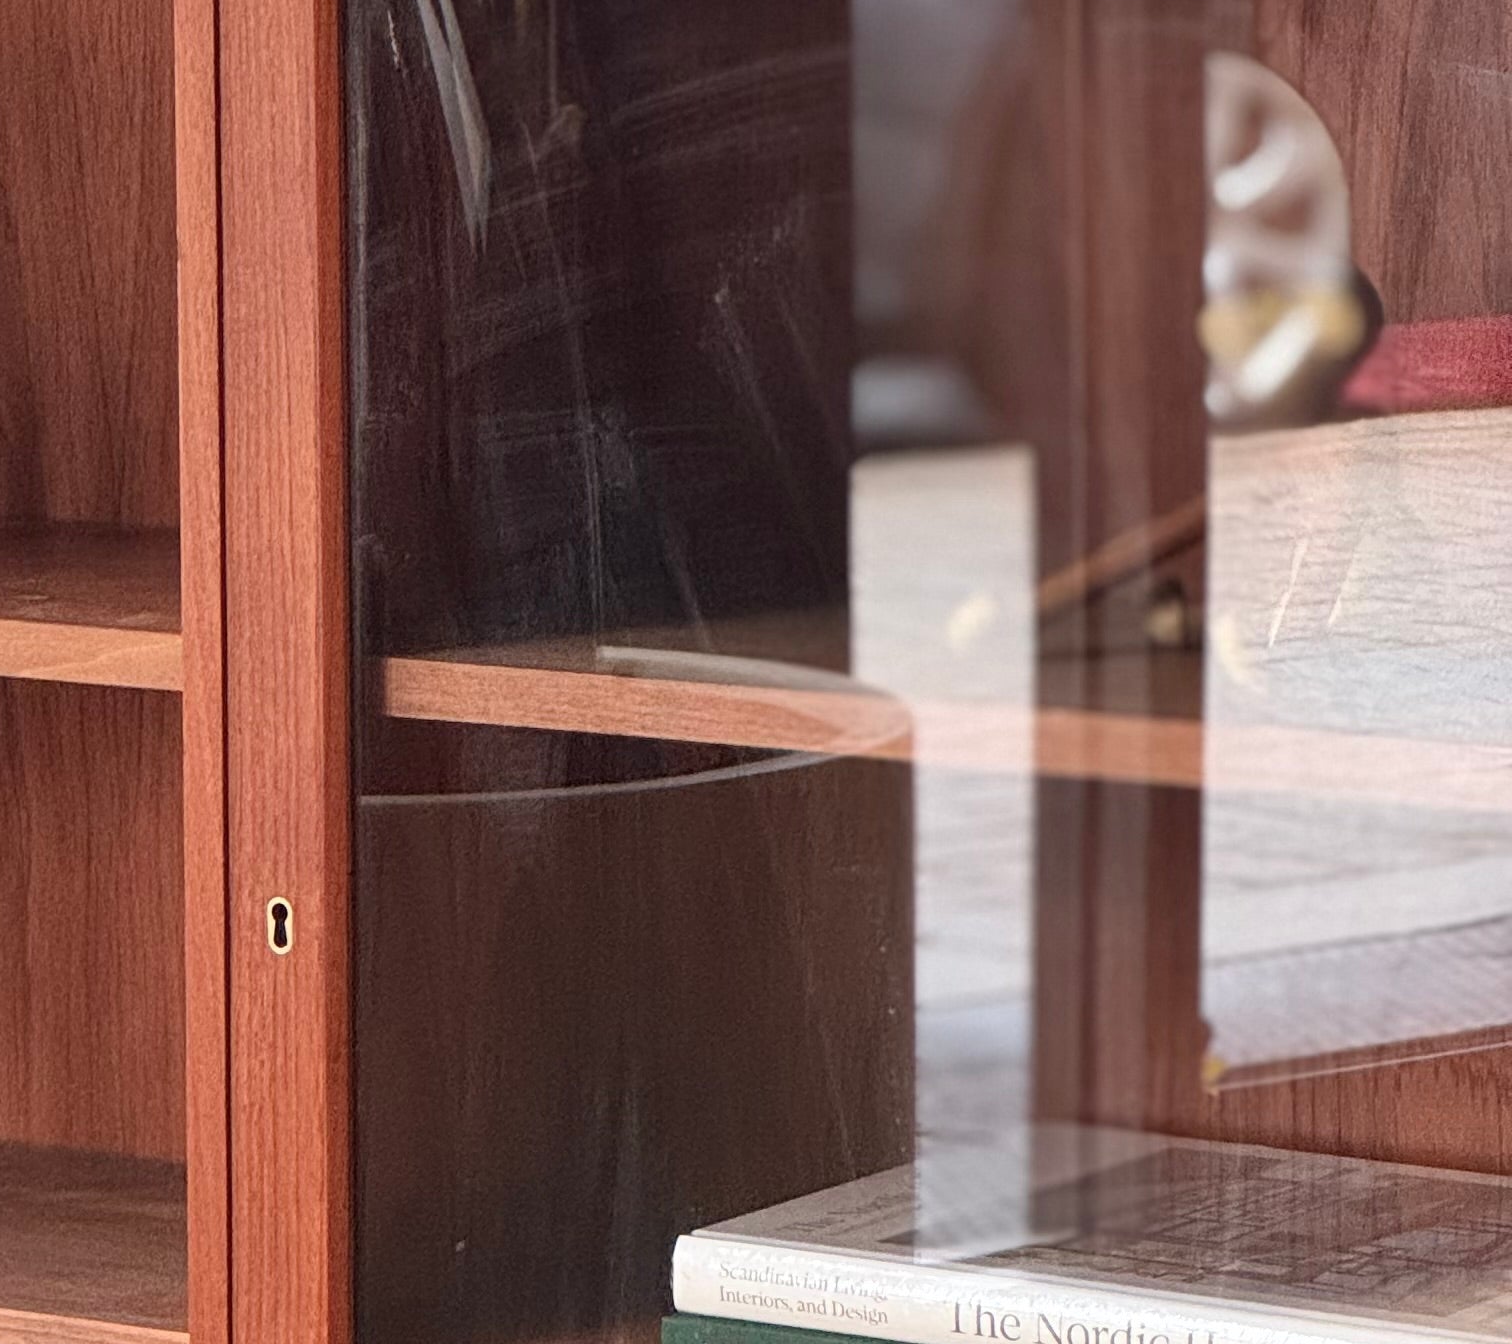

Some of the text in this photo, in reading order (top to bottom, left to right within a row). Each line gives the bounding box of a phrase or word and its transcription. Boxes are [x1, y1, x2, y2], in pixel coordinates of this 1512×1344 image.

[719, 1285, 888, 1325] Interiors, and Design
[951, 1297, 1021, 1342] The
